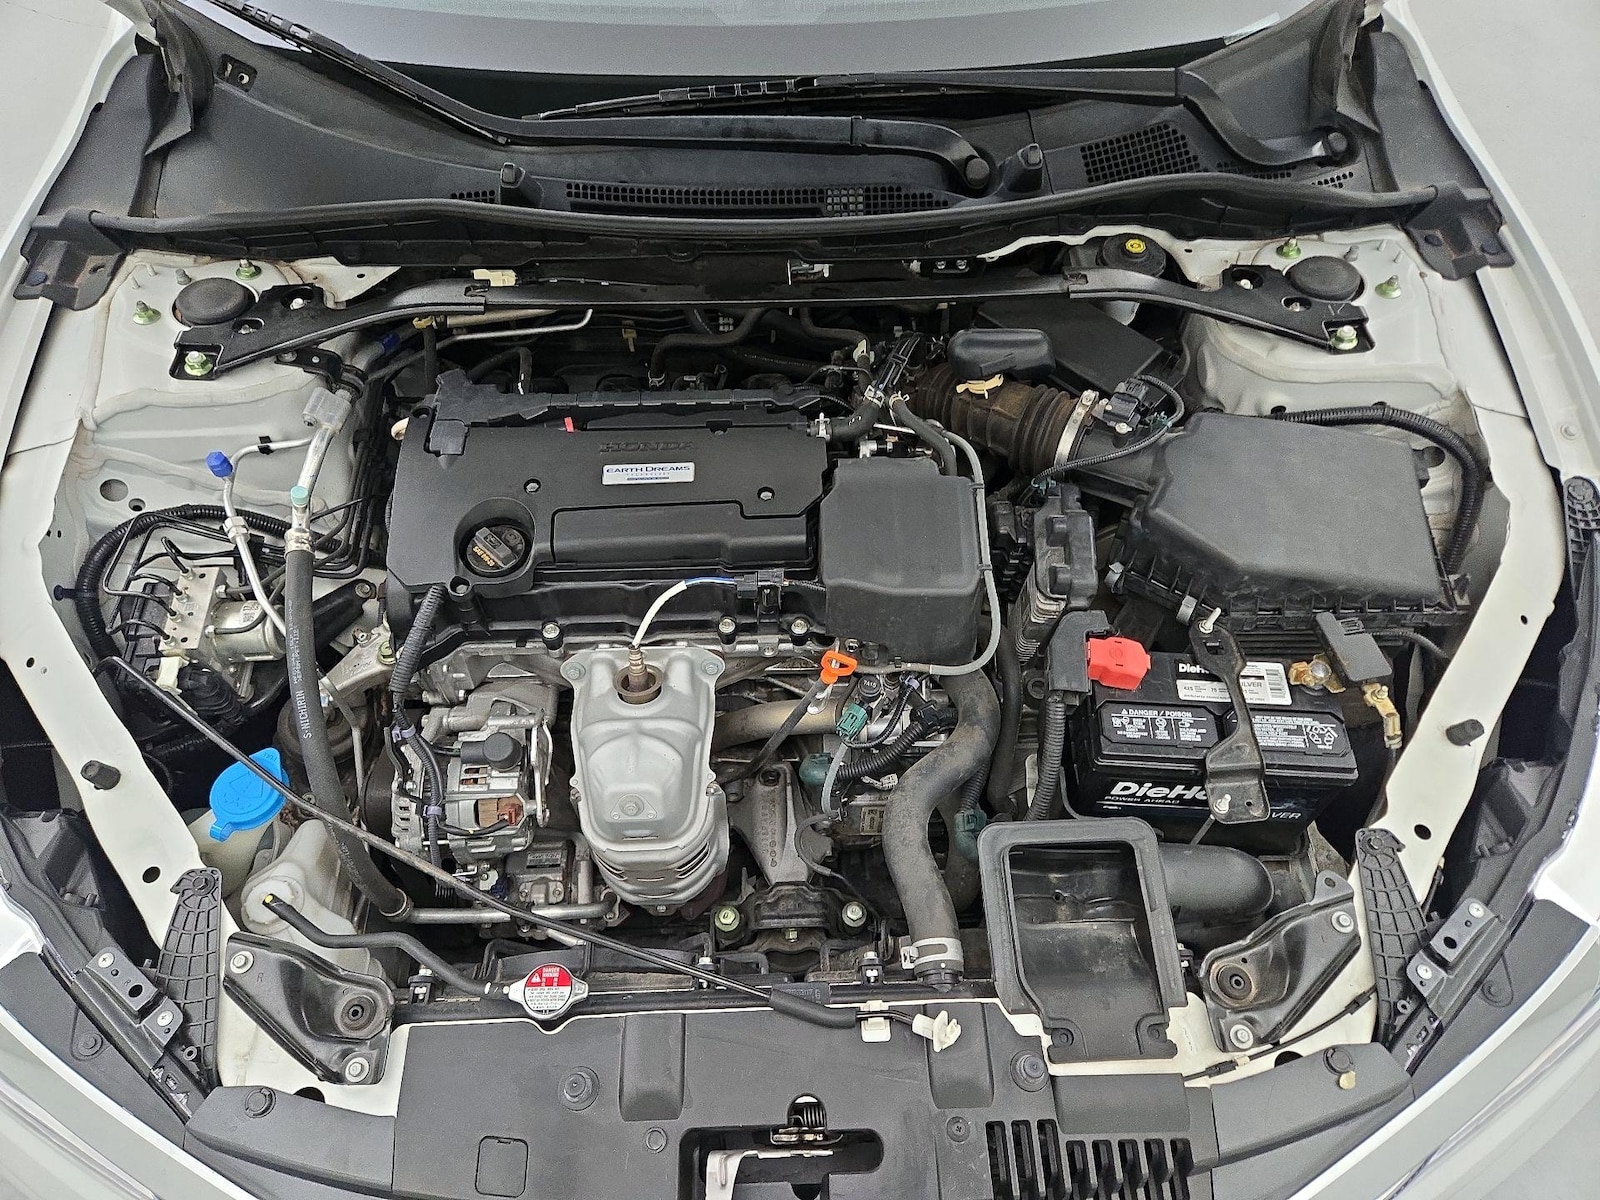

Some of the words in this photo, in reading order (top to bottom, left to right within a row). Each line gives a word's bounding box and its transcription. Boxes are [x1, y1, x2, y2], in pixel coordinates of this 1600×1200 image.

[599, 441, 697, 454] HONDA
[1178, 663, 1209, 674] DieH
[1110, 781, 1207, 800] DieH
